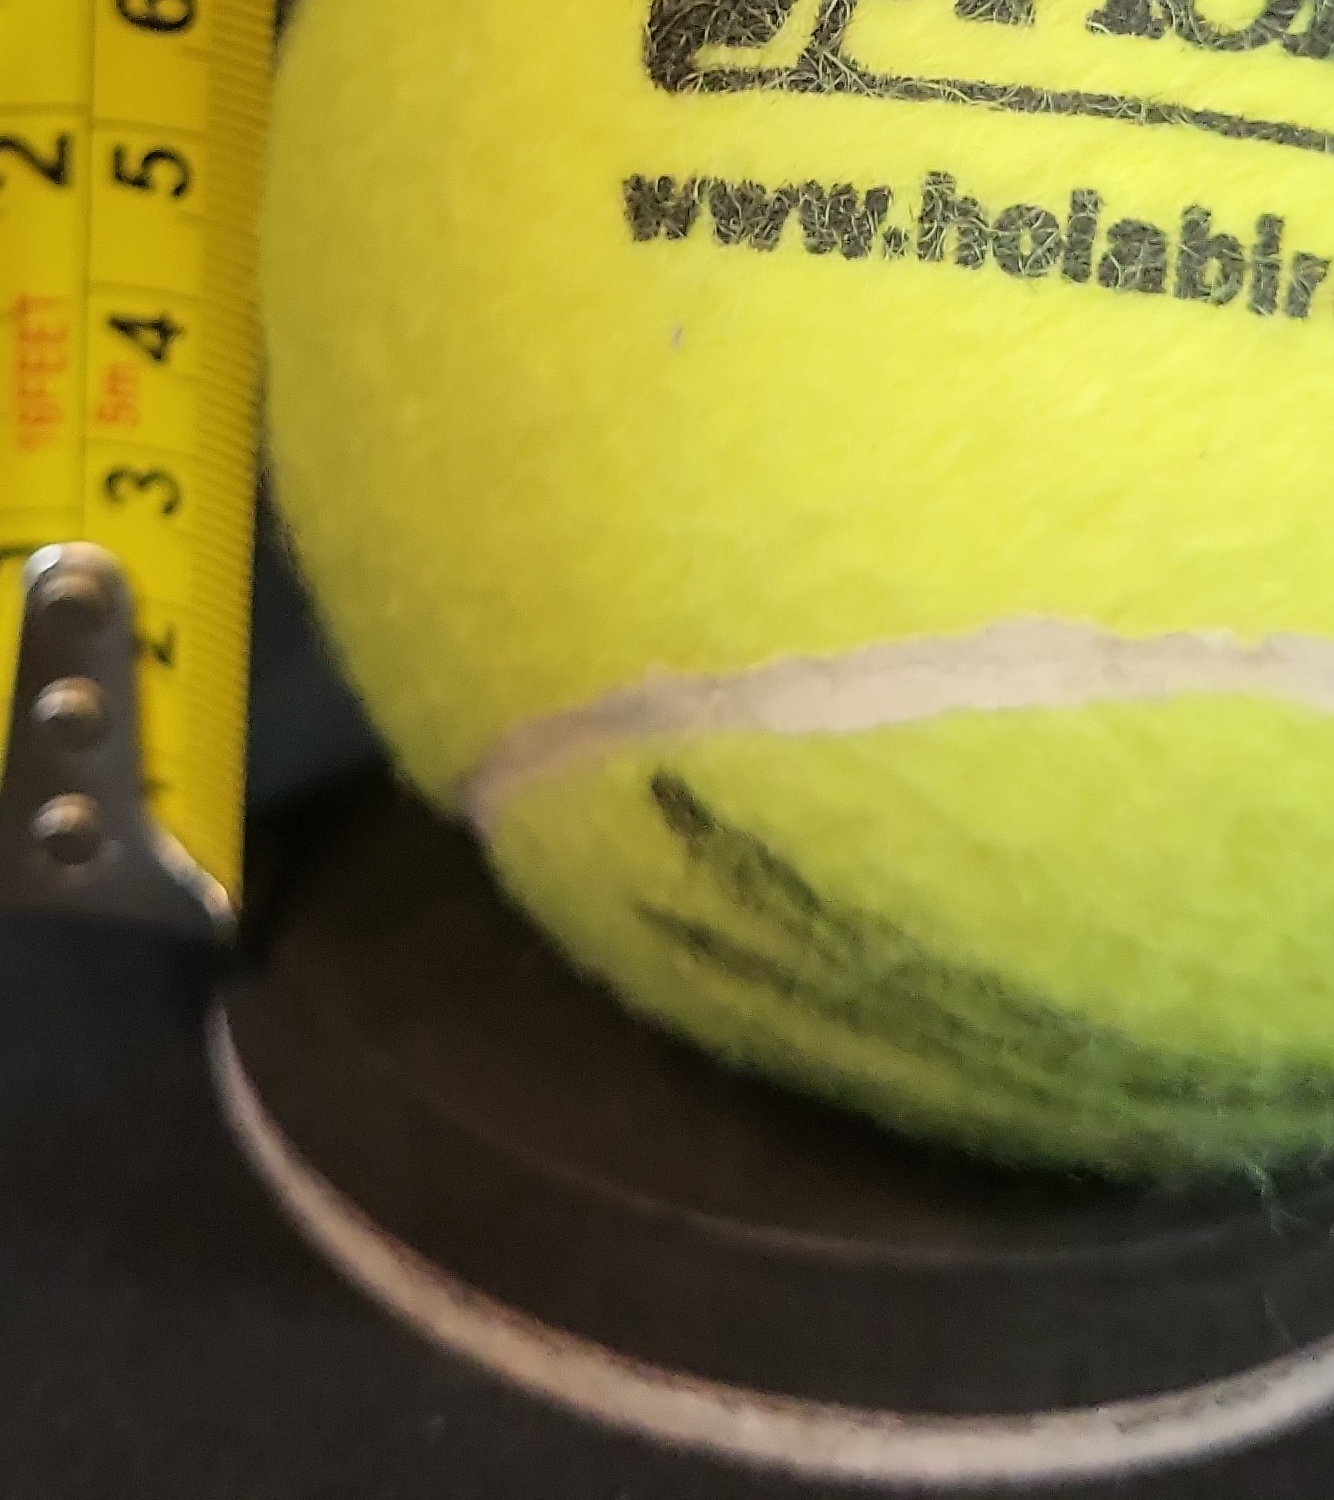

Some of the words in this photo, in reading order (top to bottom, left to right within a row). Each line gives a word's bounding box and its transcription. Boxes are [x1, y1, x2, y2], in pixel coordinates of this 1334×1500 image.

[112, 144, 193, 199] 5
[108, 312, 184, 363] 4
[104, 465, 181, 516] 3
